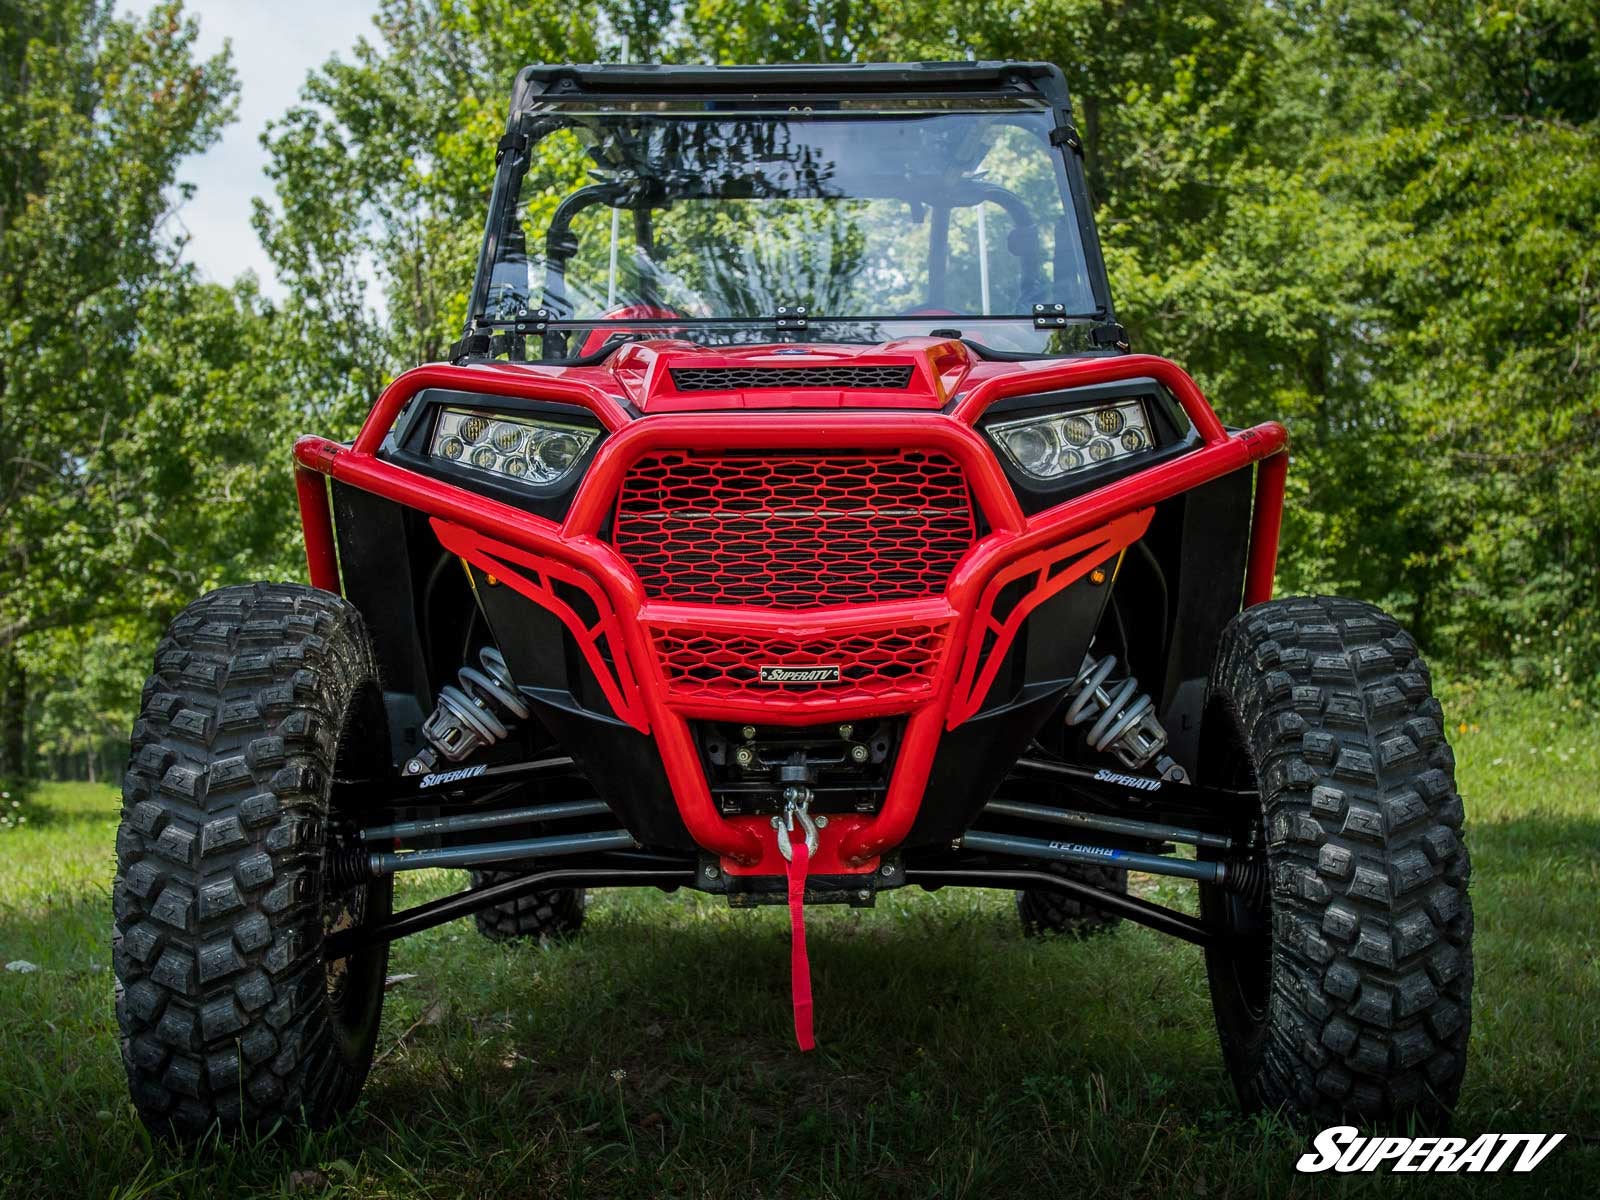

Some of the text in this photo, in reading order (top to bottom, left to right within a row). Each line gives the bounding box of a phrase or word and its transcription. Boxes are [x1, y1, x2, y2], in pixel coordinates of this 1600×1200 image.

[767, 669, 833, 681] SUPERATV
[419, 764, 487, 789] SUPERATV
[1094, 769, 1161, 791] SUPERATV
[1073, 845, 1114, 856] RHINO
